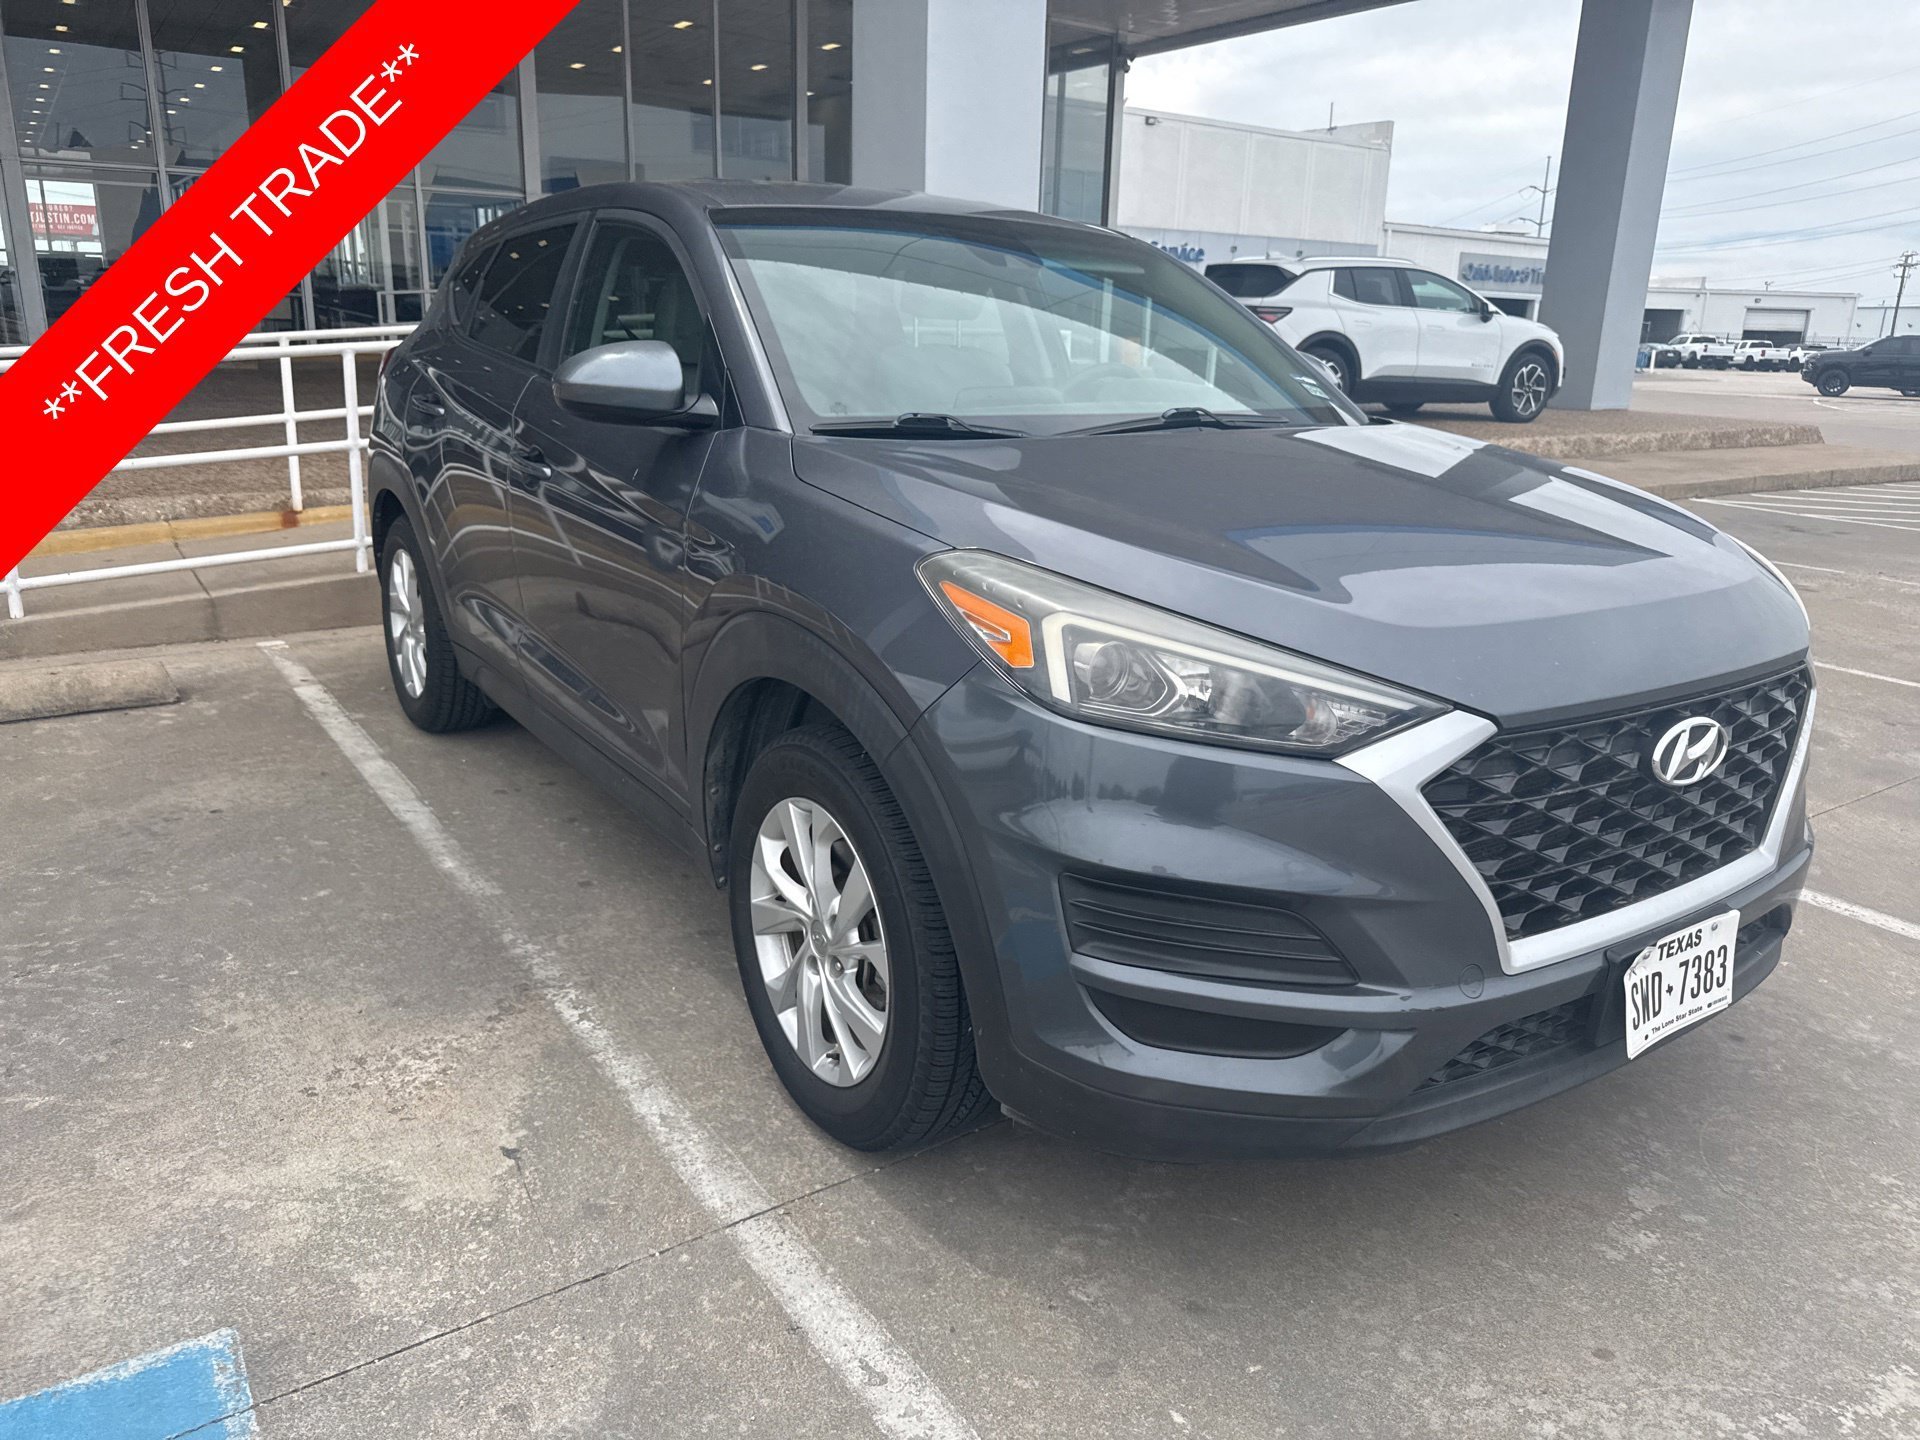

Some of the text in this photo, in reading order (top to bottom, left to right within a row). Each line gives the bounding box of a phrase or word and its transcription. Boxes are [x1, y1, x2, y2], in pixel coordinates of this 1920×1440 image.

[1657, 928, 1703, 961] TEXAS
[1678, 944, 1728, 1006] 7383
[1651, 1026, 1661, 1034] The
[1675, 1012, 1687, 1022] Star
[1688, 1006, 1703, 1016] State
